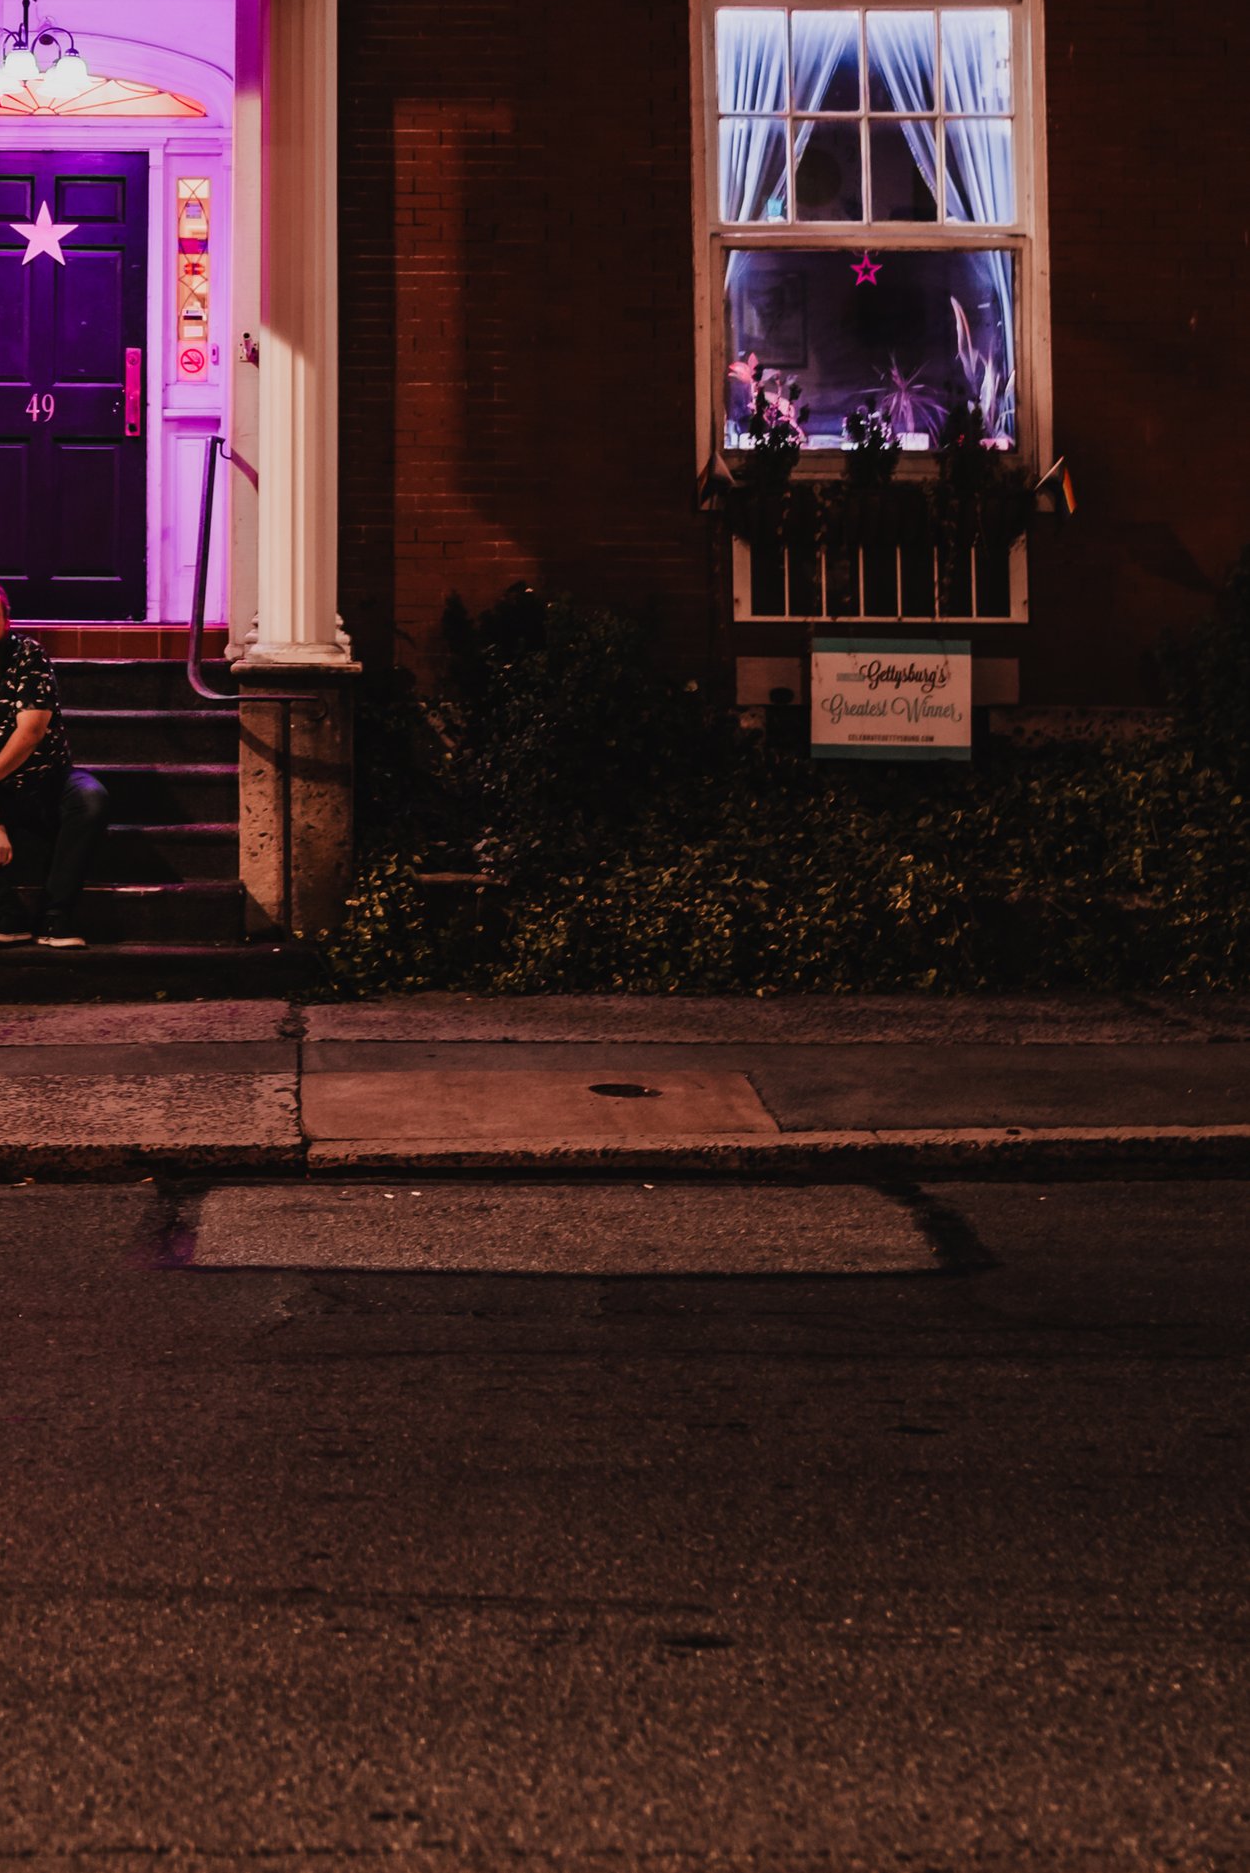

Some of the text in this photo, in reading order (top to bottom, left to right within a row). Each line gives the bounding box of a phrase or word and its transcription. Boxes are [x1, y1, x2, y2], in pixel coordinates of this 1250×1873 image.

[25, 393, 55, 422] 49
[858, 660, 947, 693] Gettysburg's
[820, 693, 963, 724] Greatest Winner
